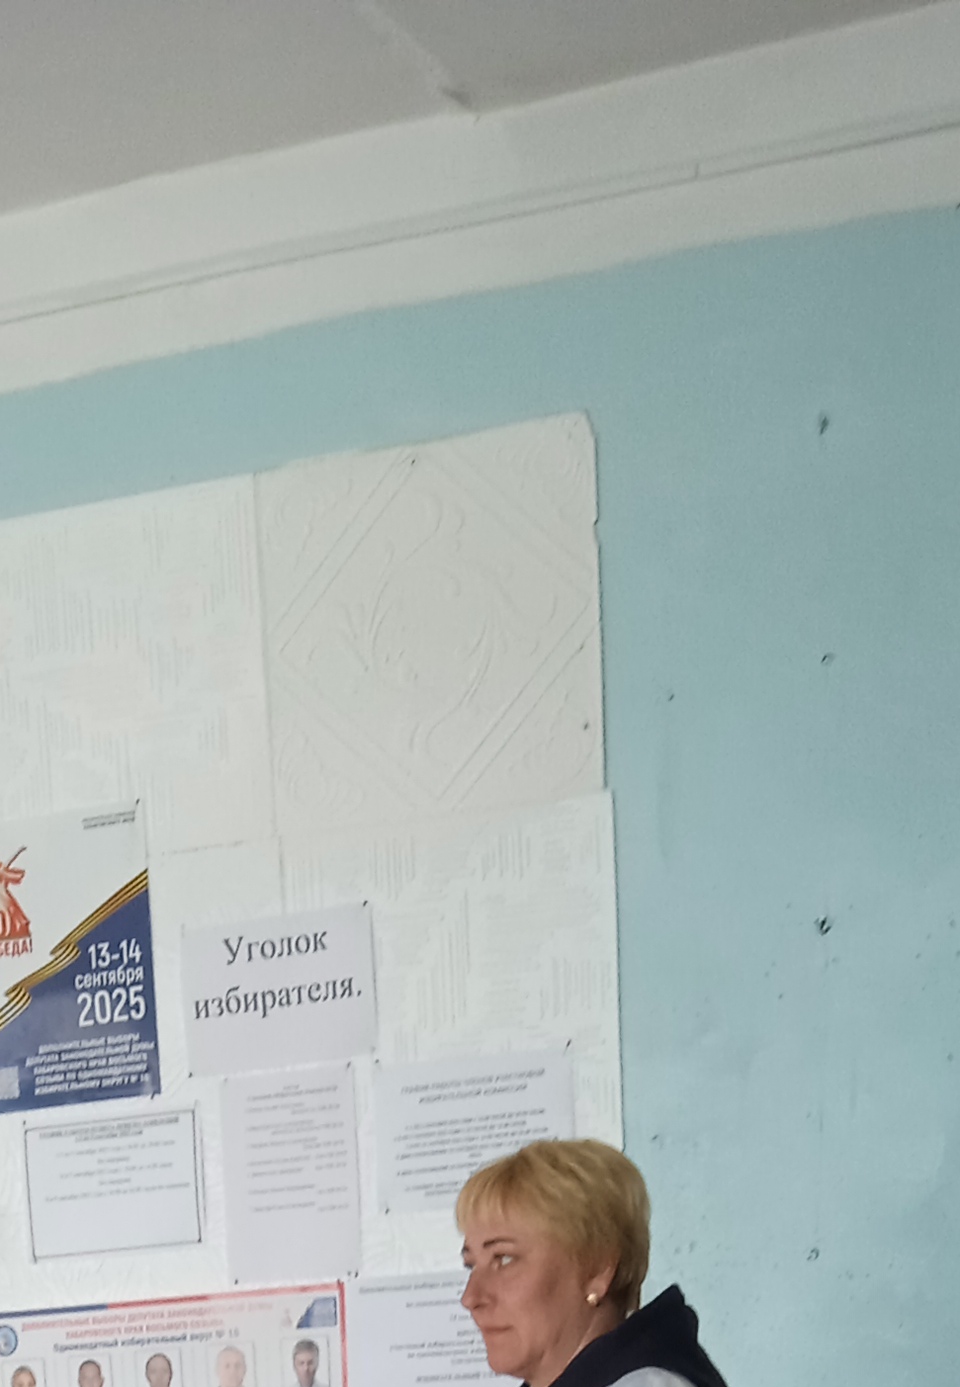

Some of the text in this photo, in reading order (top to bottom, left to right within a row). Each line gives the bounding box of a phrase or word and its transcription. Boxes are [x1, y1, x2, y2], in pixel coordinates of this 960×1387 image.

[88, 938, 142, 969] 13-14
[221, 930, 328, 967] Уголок
[75, 965, 144, 990] сентября
[77, 985, 146, 1027] 2025
[193, 977, 362, 1021] избирателя.
